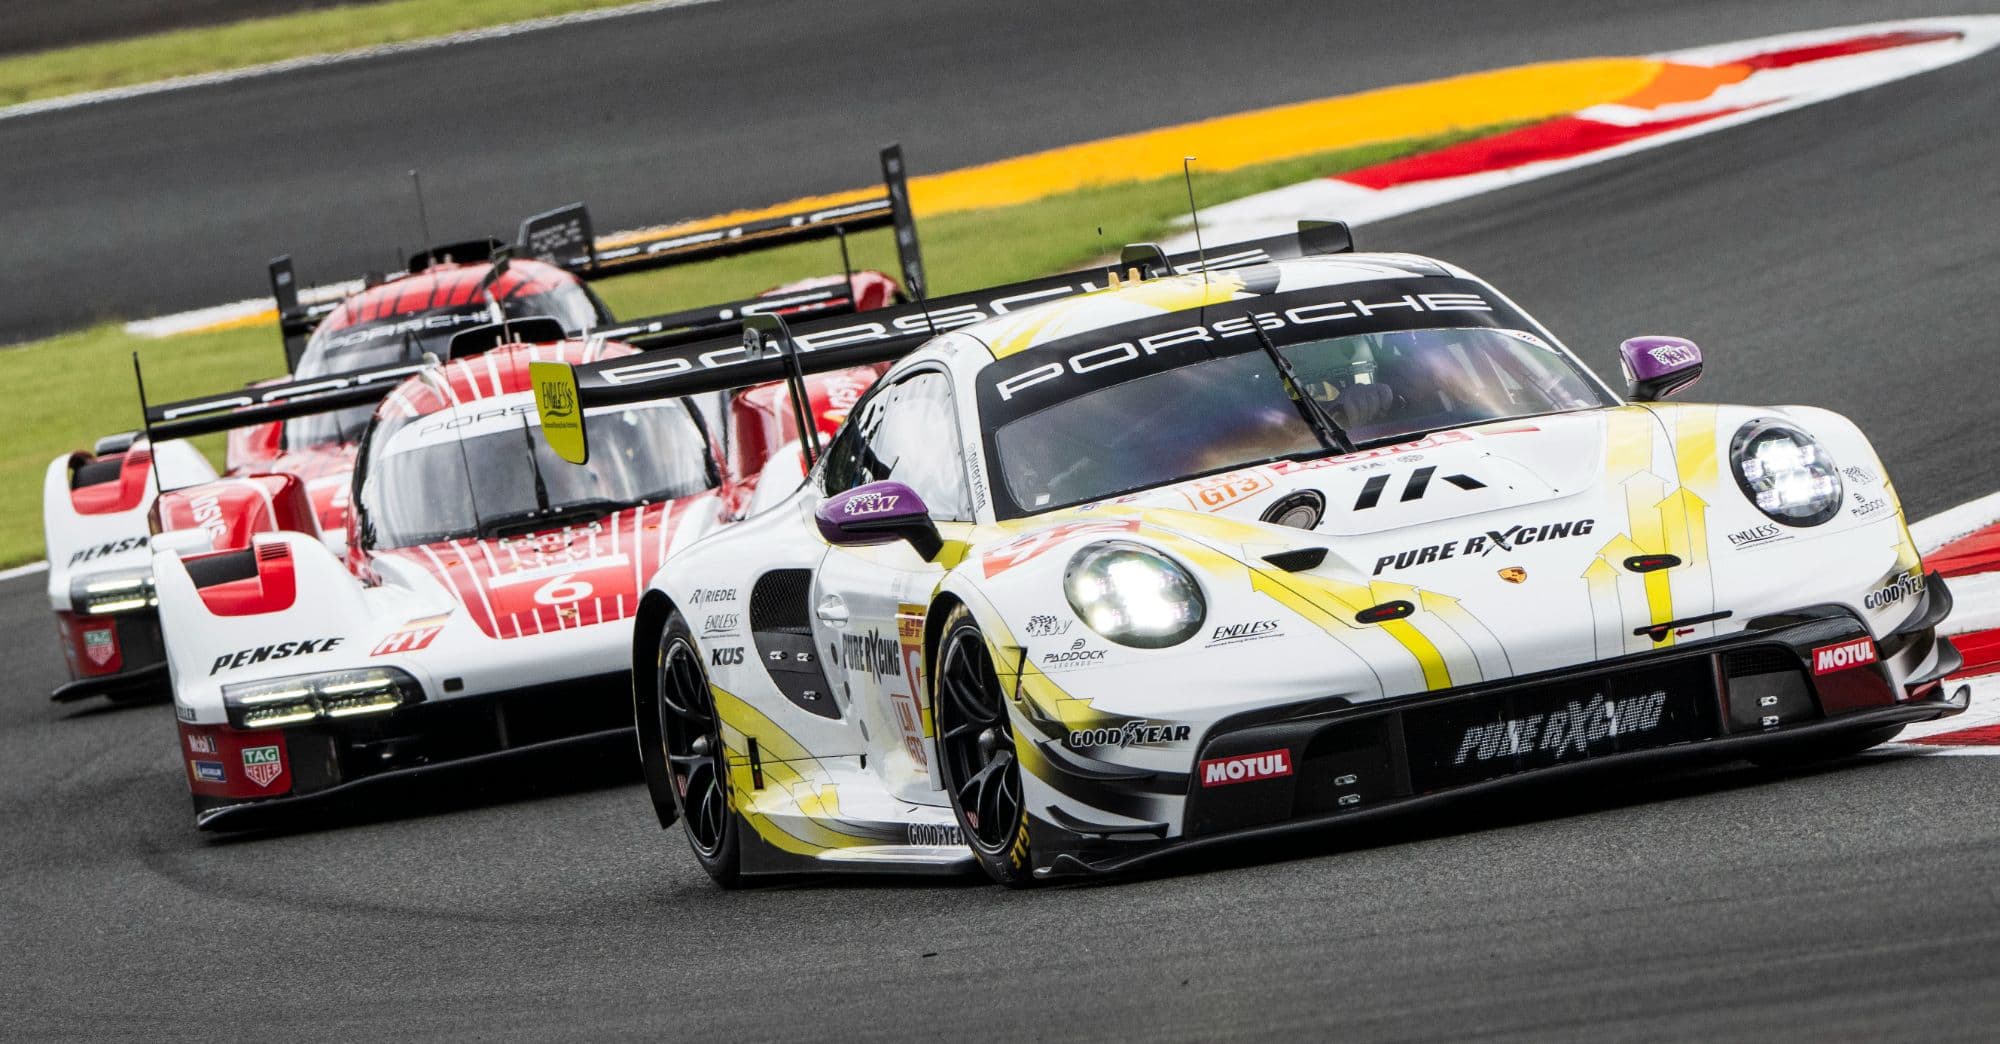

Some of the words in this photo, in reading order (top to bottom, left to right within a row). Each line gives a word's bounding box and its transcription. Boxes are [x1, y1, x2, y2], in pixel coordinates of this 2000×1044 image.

[995, 293, 1493, 401] PORSCHE
[847, 493, 900, 515] KW
[1200, 477, 1260, 507] GT3
[1372, 541, 1458, 576] PURE
[1463, 519, 1595, 557] RXCING
[1727, 523, 1780, 545] ENDLESS
[533, 572, 594, 605] 6
[704, 613, 740, 630] ENDLESS
[1212, 619, 1280, 640] ENDLESS
[209, 637, 345, 676] PENSKE
[842, 633, 865, 672] PURE
[1043, 649, 1108, 664] PADDOCK
[1816, 640, 1875, 671] MOTUL
[1069, 721, 1192, 748] GOODYEAR
[1454, 713, 1544, 766] PURE
[245, 750, 277, 763] TAG
[1206, 755, 1288, 783] MOTUL
[247, 763, 281, 783] HEUER
